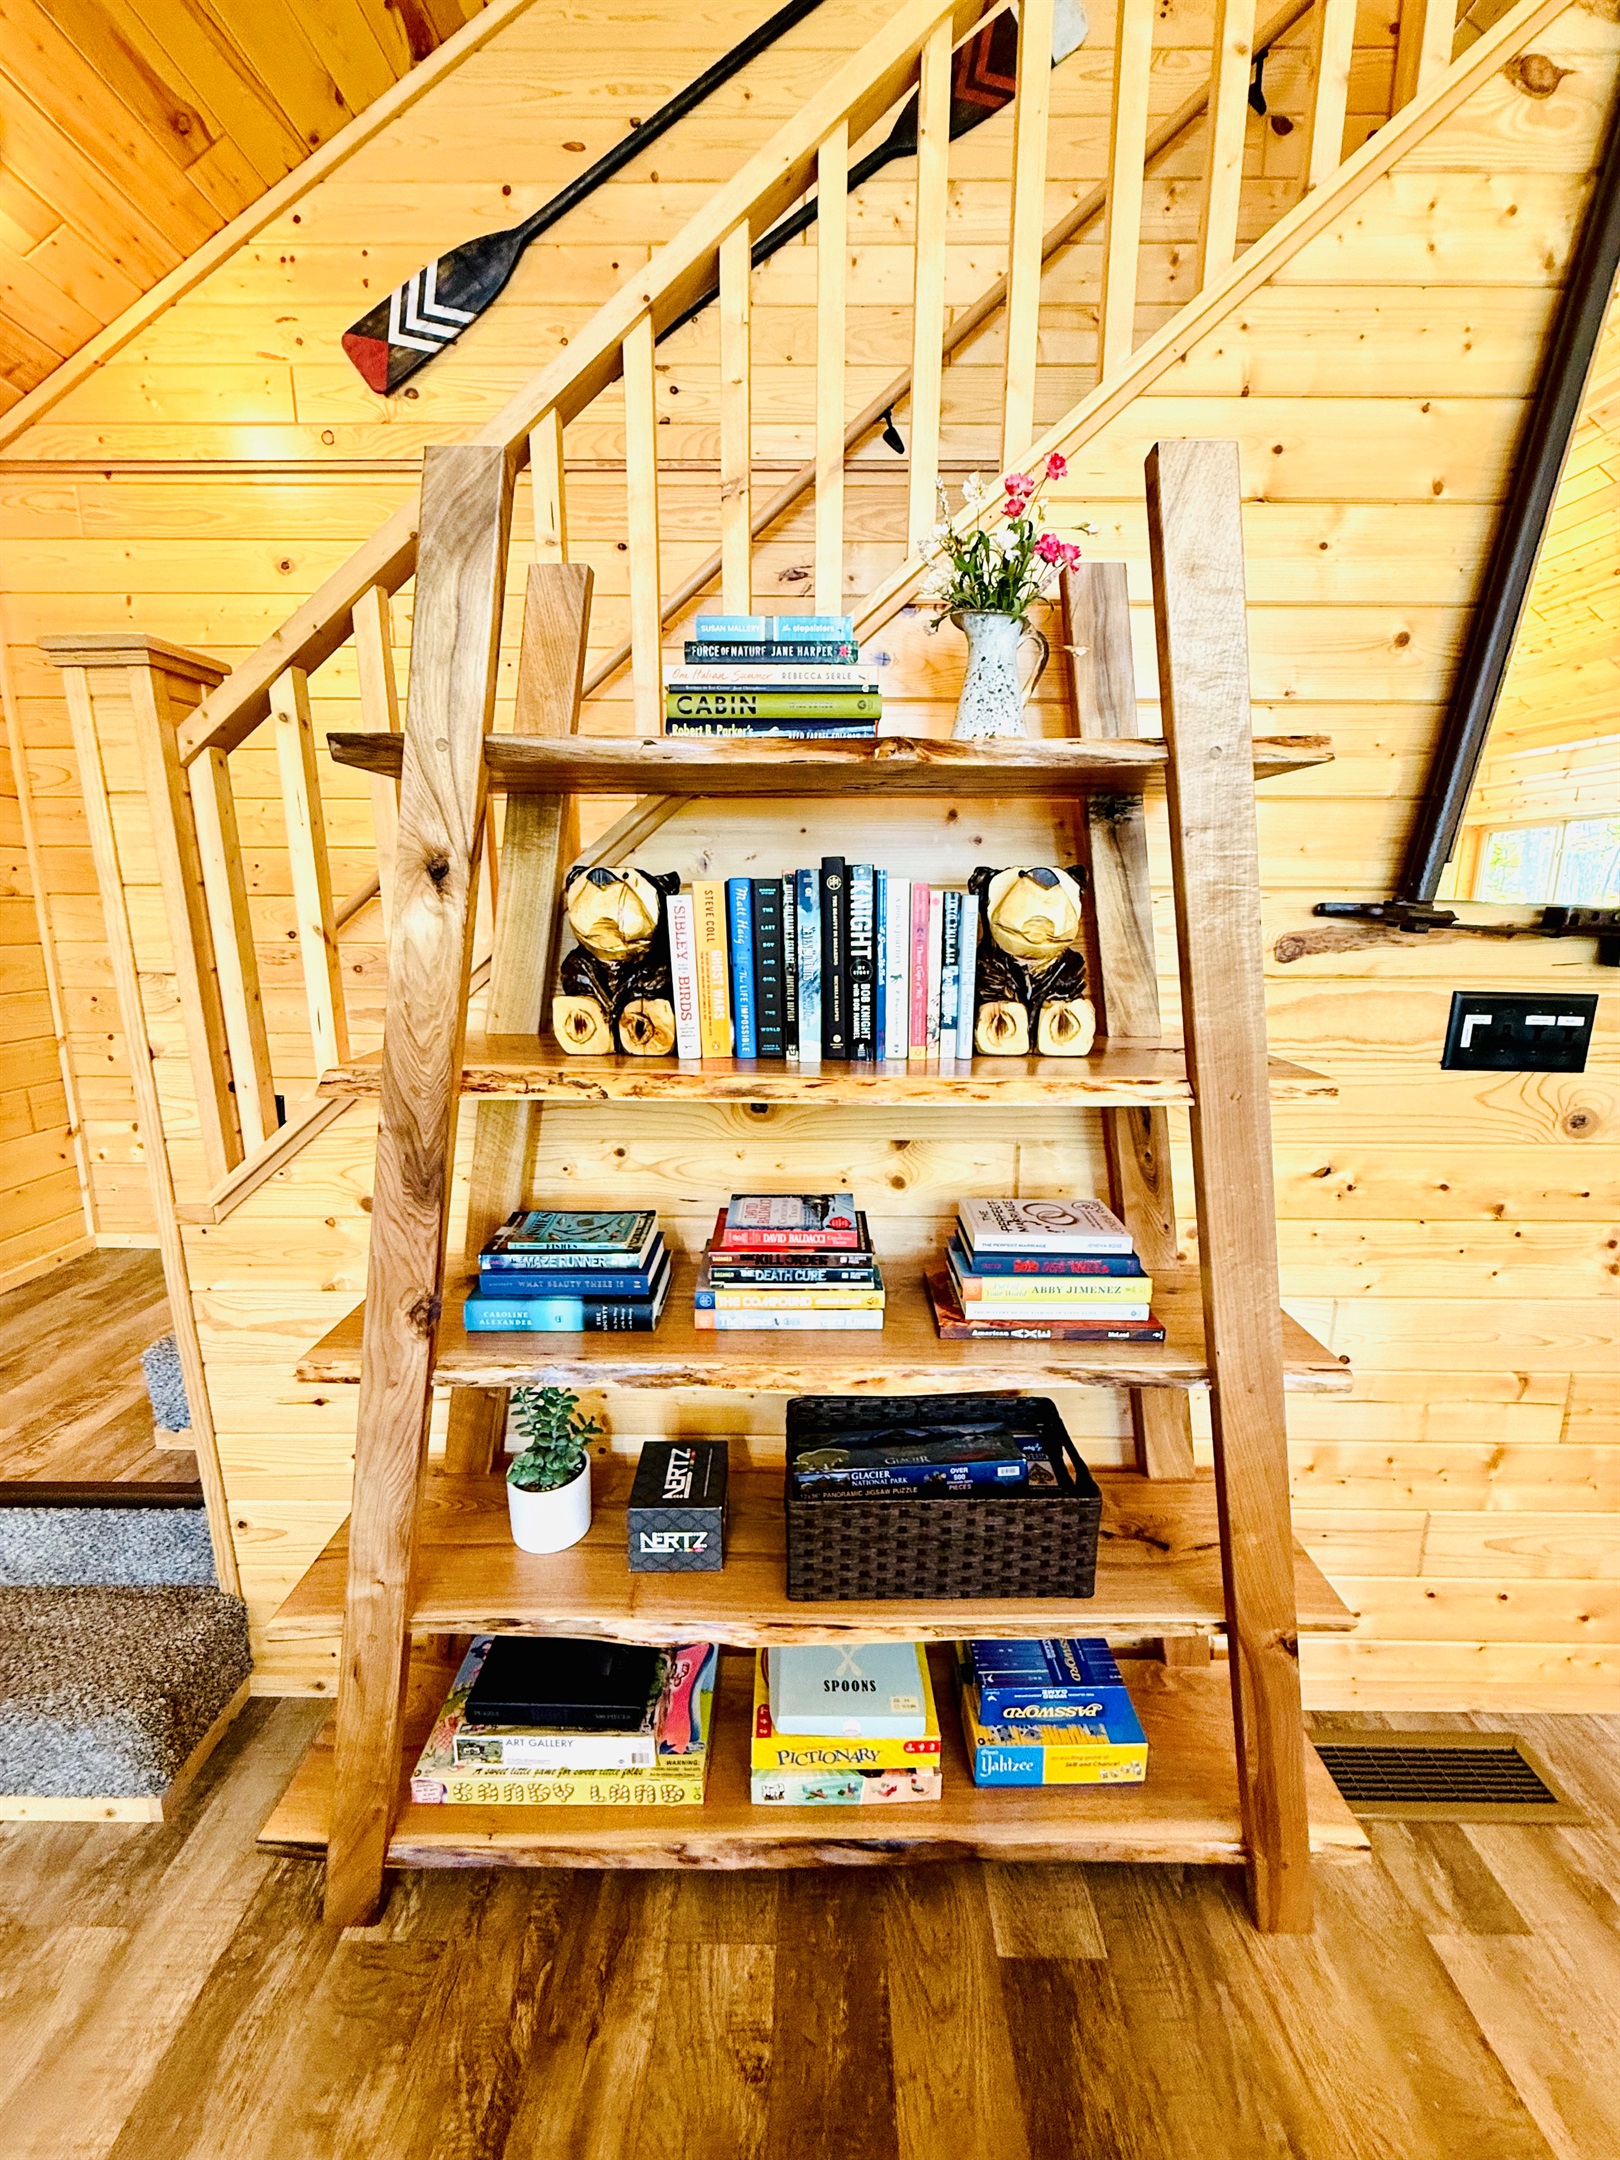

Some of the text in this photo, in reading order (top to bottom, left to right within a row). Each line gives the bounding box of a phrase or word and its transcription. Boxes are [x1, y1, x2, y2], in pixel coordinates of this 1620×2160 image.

[700, 624, 760, 632] SUSAN MALLERY
[692, 645, 766, 657] FORCE OF NATURE
[771, 645, 833, 657] JANE HARPER
[672, 669, 773, 682] One Italian Summer
[782, 672, 851, 680] REBECCA SERLE
[676, 695, 756, 715] CABIN
[672, 723, 703, 737] Robert
[716, 723, 753, 737] Parker's
[704, 890, 714, 917] STEVE
[734, 886, 749, 945] Matt Haig
[850, 879, 872, 960] KNIGHT
[673, 905, 688, 961] SIBLEY
[706, 921, 715, 942] COLL
[802, 925, 816, 949] SEVEN
[945, 897, 958, 964] INTO THIN AIR
[966, 912, 977, 970] JOHN GRISHAM
[802, 949, 815, 981] SUMMITS
[914, 965, 924, 981] Cups
[711, 950, 725, 1019] GHOST WARS
[786, 975, 795, 996] HOPKINS
[852, 983, 860, 997] with
[678, 976, 692, 1021] BIRDS
[739, 970, 750, 1052] The LIFE IMPOSSIBLE
[786, 1001, 795, 1021] HOPKINS
[860, 983, 871, 1040] BOB KNIGHT
[744, 1203, 759, 1219] DAVID
[757, 1199, 772, 1224] BALDACCI
[979, 1210, 991, 1221] THE
[987, 1201, 1013, 1233] PERFECT
[1002, 1200, 1029, 1232] MARRIAGE
[763, 1233, 826, 1244] DAVID BALDACCI
[523, 1256, 558, 1268] MAZE
[559, 1256, 607, 1267] RUNNER
[755, 1255, 783, 1265] KILL
[785, 1255, 828, 1266] ORDER
[740, 1269, 827, 1281] THE DEATH CURE
[547, 1280, 581, 1288] BEAUTY
[585, 1280, 613, 1288] THERE
[616, 1280, 624, 1288] IS
[1032, 1286, 1122, 1294] ABBY JIMENEZ
[717, 1297, 740, 1307] THE
[742, 1296, 812, 1307] COMPOUND
[1011, 1329, 1051, 1338] AXE
[885, 1455, 931, 1465] GLACIER
[662, 1448, 691, 1499] NERTZ
[851, 1470, 891, 1480] GLACIER
[852, 1477, 908, 1487] NATIONAL PARK
[822, 1490, 863, 1499] PANORAMIC
[865, 1488, 891, 1496] JIGSAW
[640, 1532, 708, 1549] NERTZ
[823, 1679, 877, 1692] SPOONS
[1002, 1703, 1103, 1718] PASSWORD
[506, 1739, 574, 1748] ART GALLERY
[777, 1747, 881, 1766] PICTIONARY
[485, 1768, 507, 1776] sweet
[510, 1768, 530, 1776] little
[533, 1769, 555, 1778] game
[557, 1767, 572, 1778] for
[621, 1768, 643, 1778] folks
[980, 1754, 1034, 1778] Yahtzee
[453, 1782, 574, 1802] CANDY
[591, 1783, 685, 1803] LAND
